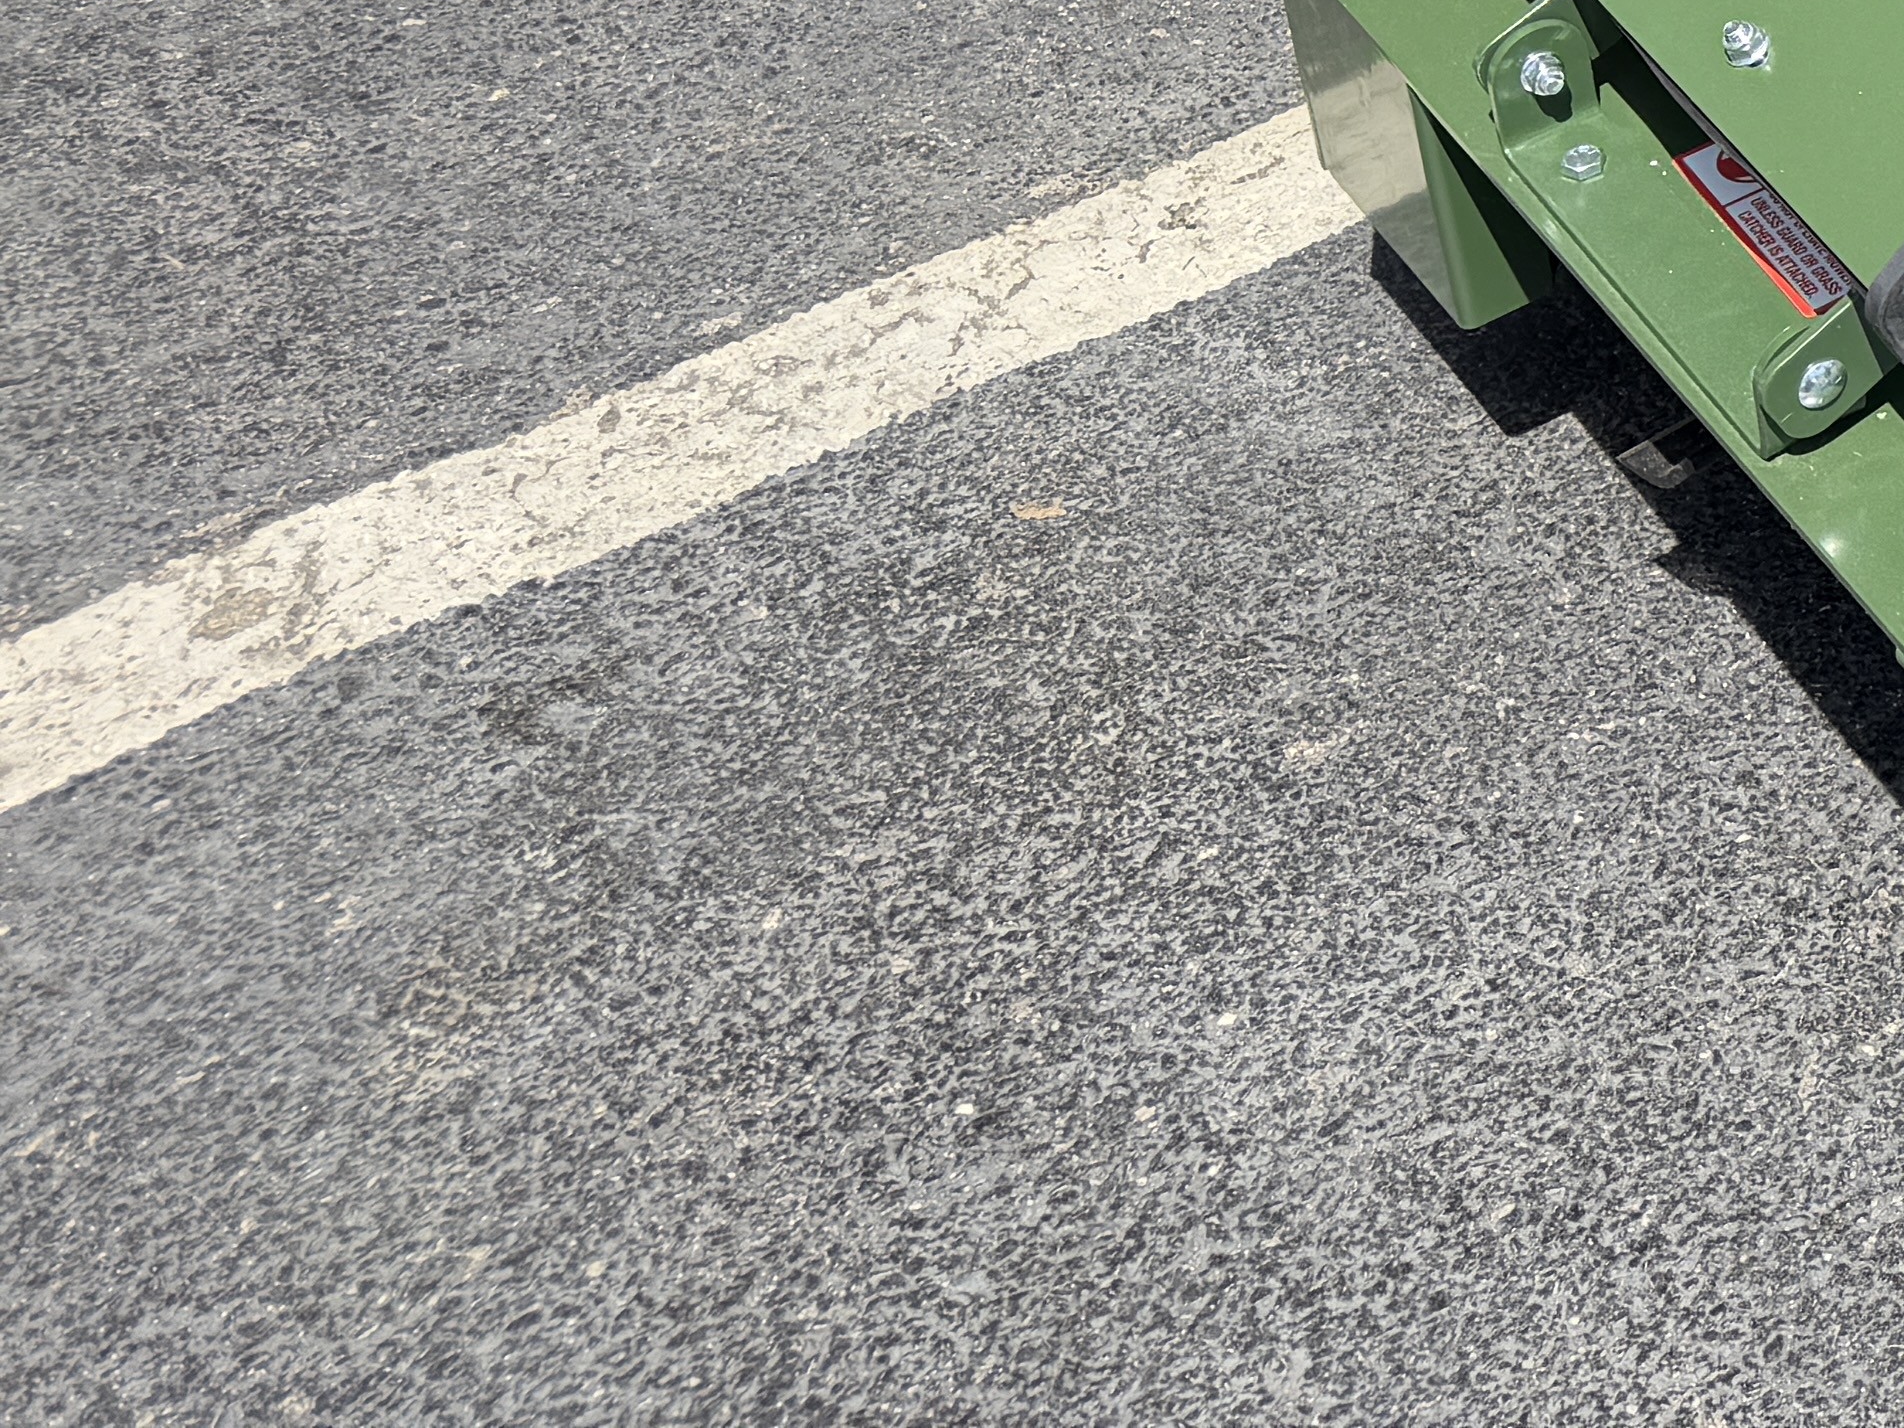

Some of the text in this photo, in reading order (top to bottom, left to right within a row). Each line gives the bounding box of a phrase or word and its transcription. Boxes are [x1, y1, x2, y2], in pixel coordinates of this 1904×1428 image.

[1738, 210, 1820, 299] CATCHER IS ATTACHED.
[1750, 196, 1843, 296] UNLESS GUARD OR GRASS
